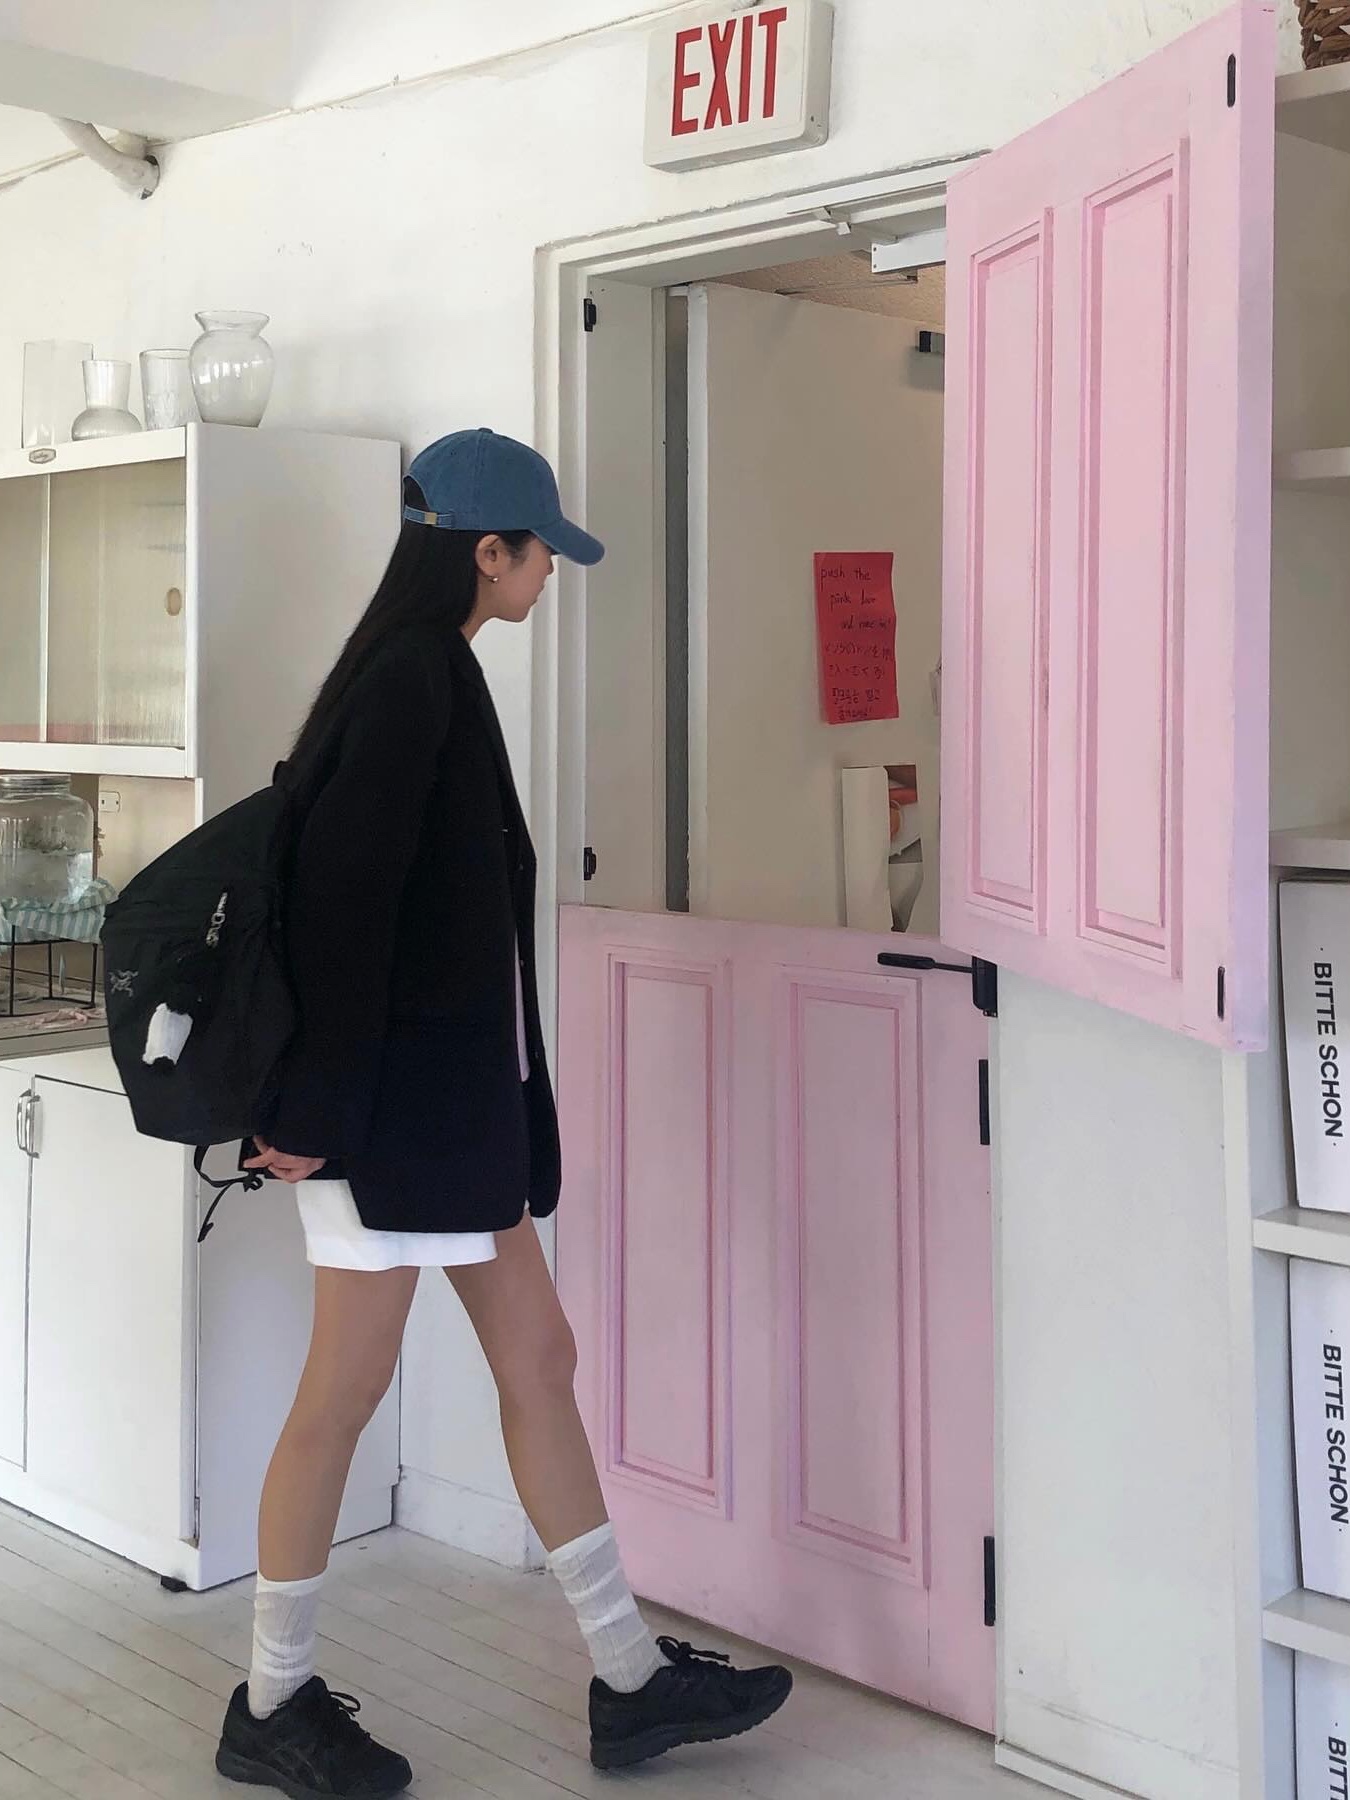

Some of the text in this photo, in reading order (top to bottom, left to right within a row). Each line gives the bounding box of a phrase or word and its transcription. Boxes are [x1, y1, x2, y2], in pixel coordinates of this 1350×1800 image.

[671, 7, 787, 136] EXIT
[820, 564, 871, 593] push the
[1313, 962, 1343, 1137] BITTE SCHON
[1323, 1343, 1349, 1524] BITTE SCHON
[1328, 1736, 1348, 1800] BITT
